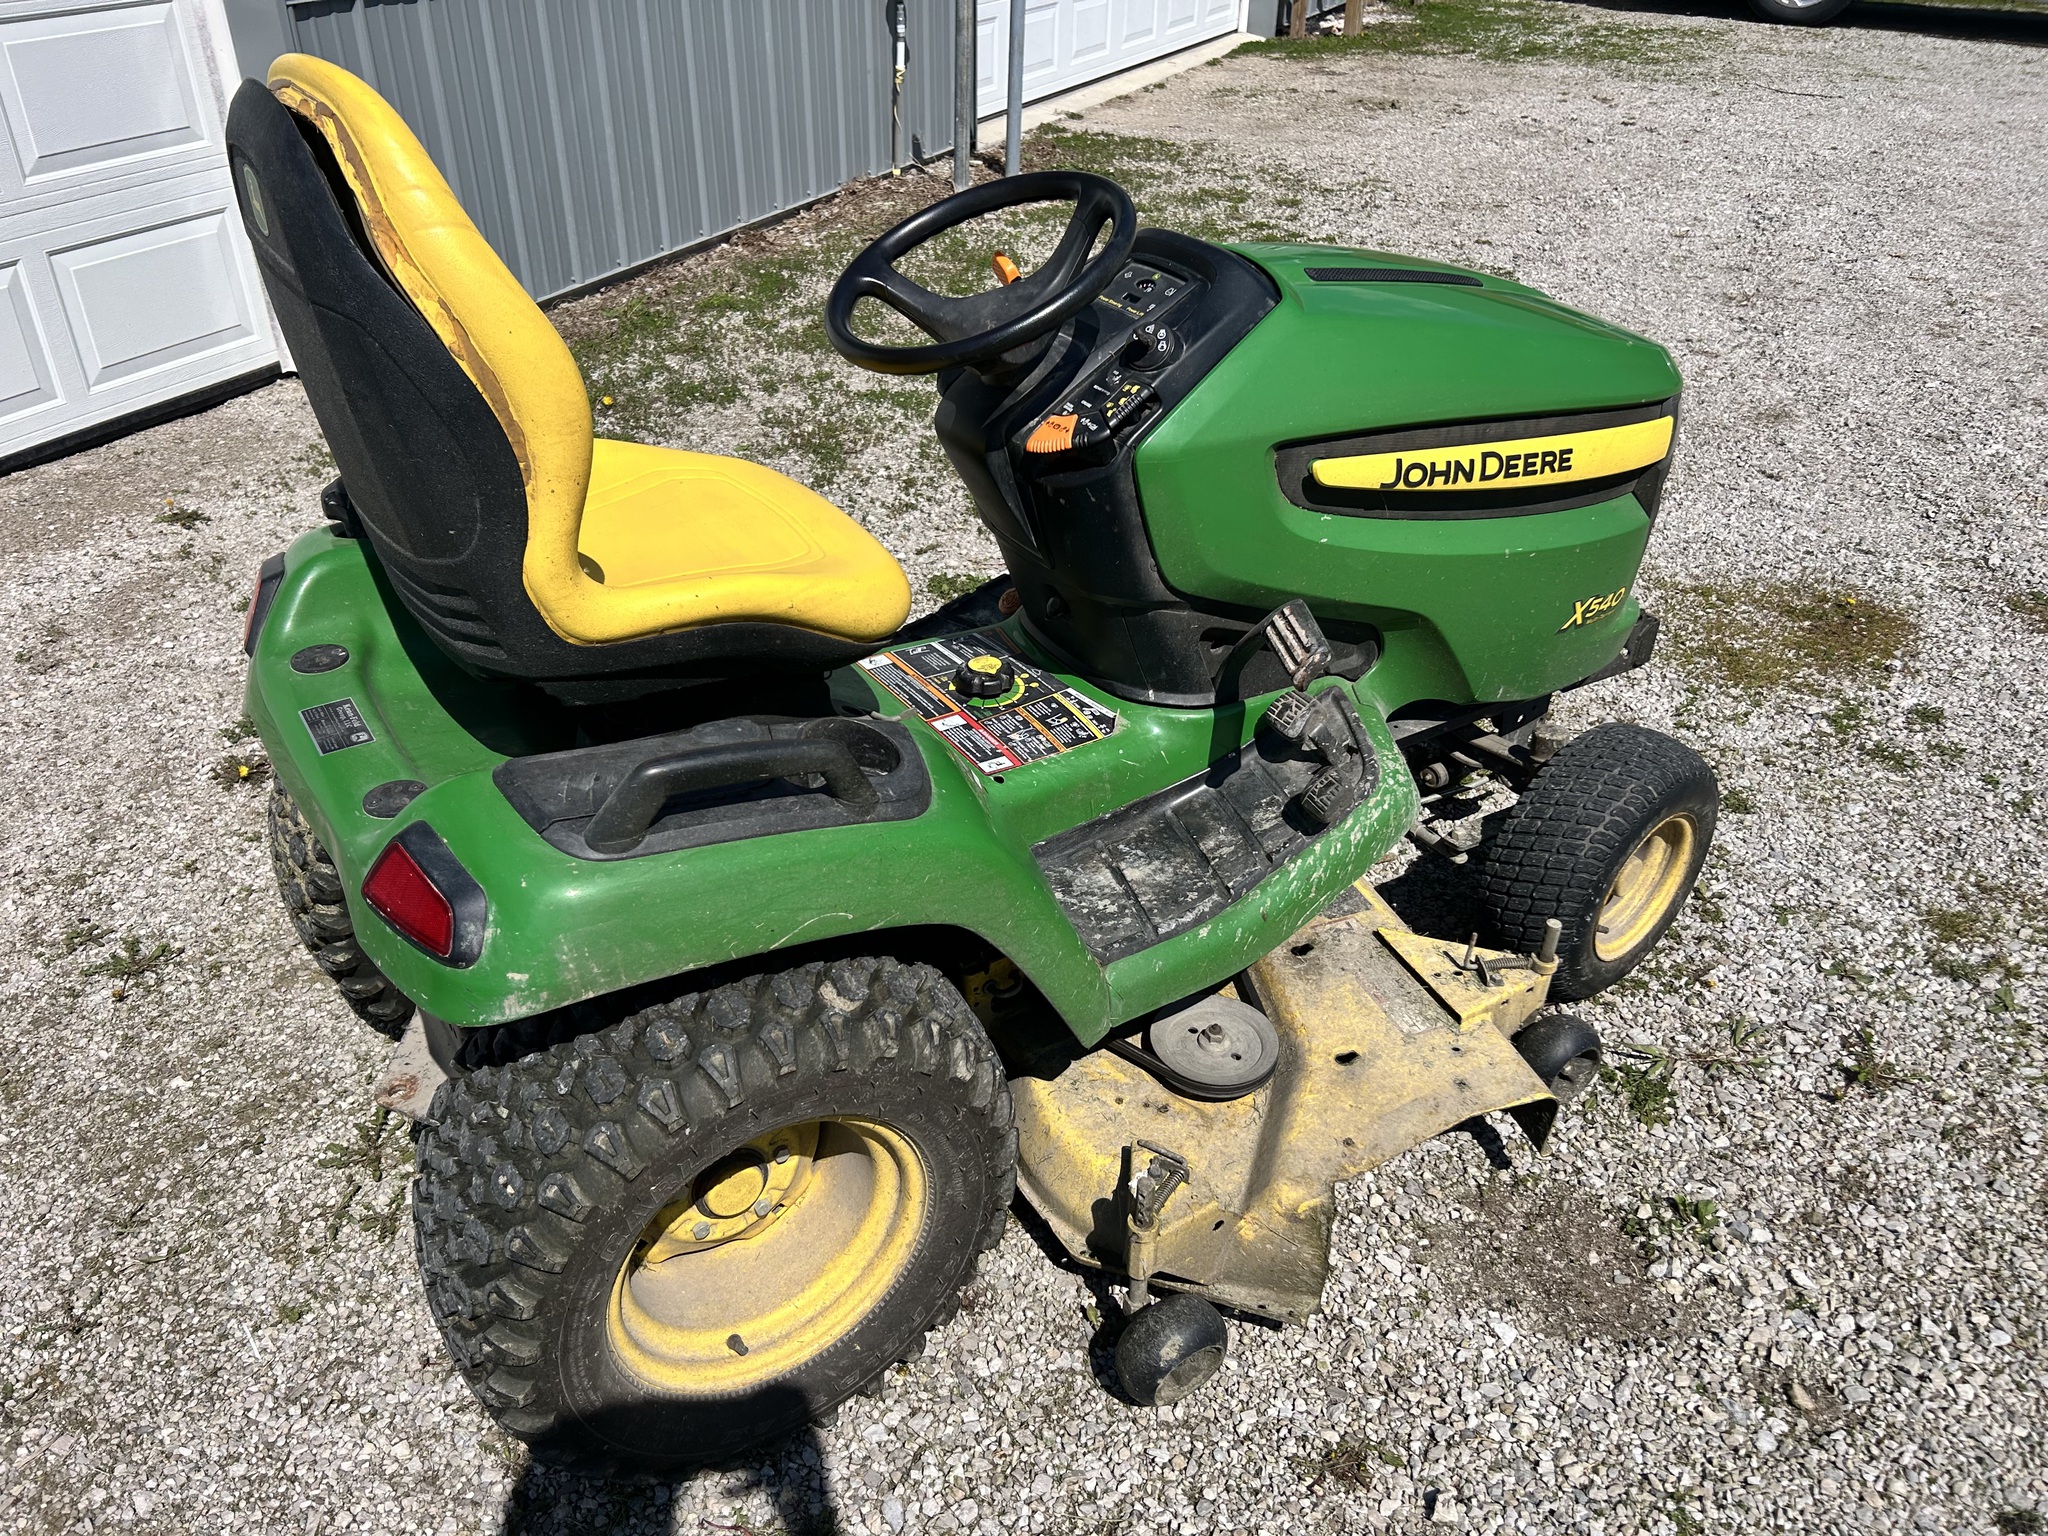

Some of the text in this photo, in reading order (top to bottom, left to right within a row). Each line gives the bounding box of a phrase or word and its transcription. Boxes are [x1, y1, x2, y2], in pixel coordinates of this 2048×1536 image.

[1380, 449, 1574, 490] JOHN DEERE
[1559, 587, 1626, 631] X540
[595, 1094, 819, 1262] CARLISLE
